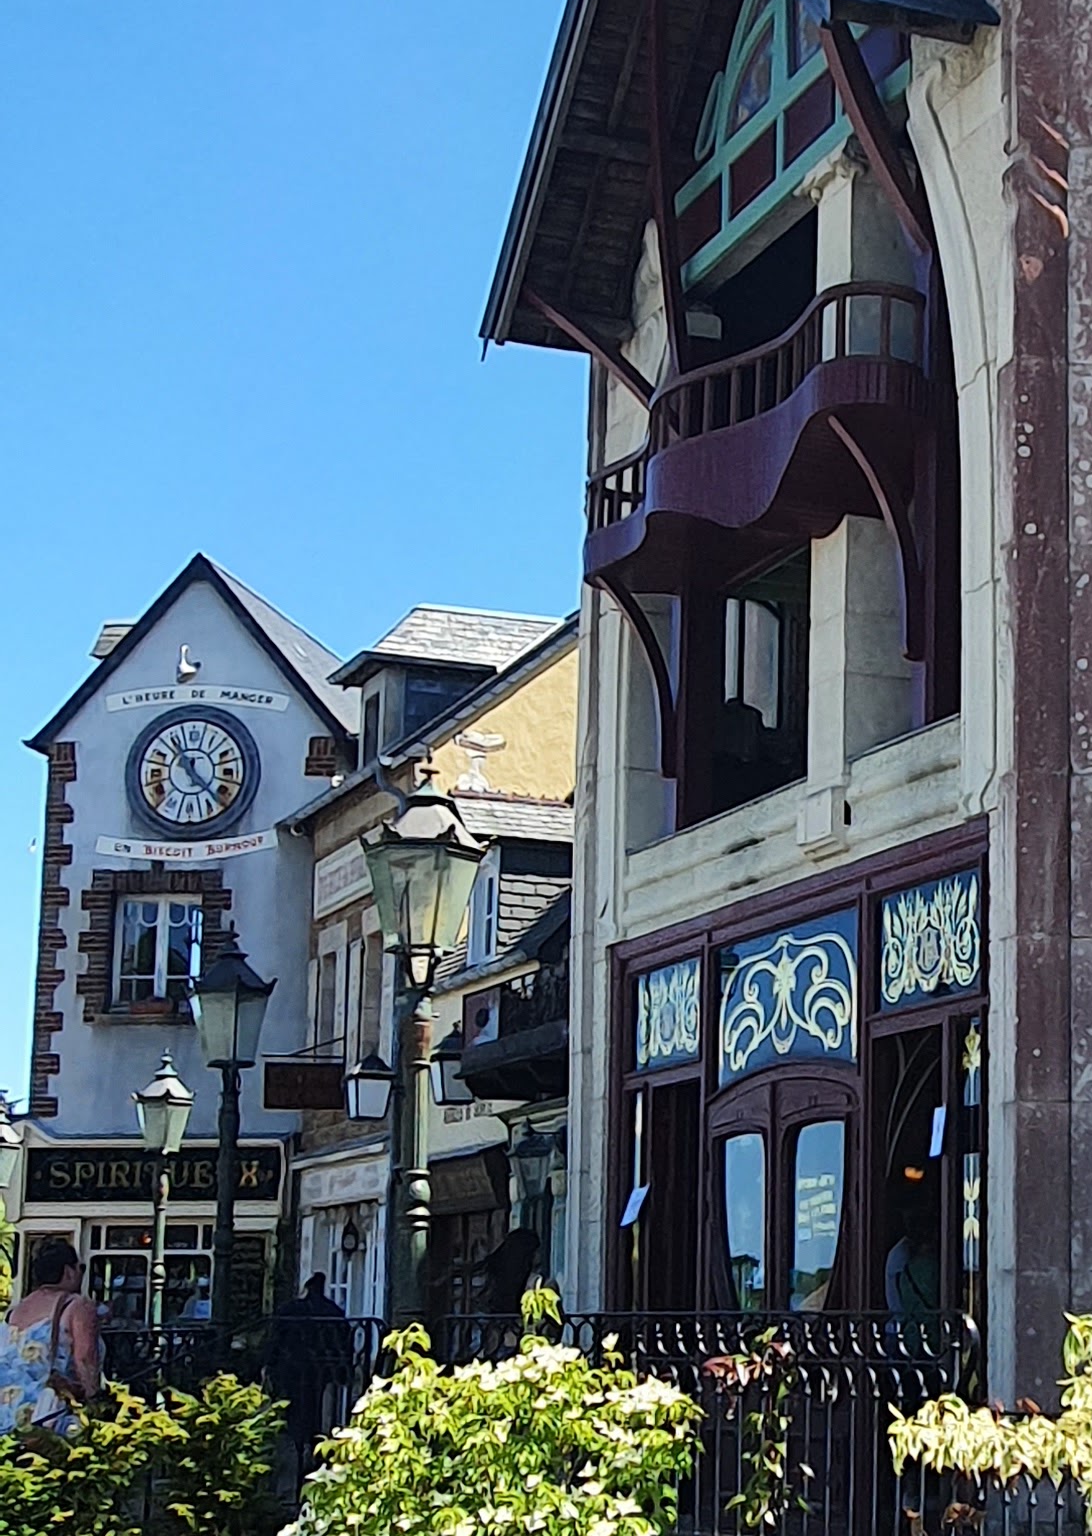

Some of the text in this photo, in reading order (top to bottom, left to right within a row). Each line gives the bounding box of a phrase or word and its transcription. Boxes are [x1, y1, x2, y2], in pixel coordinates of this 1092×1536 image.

[191, 689, 206, 698] DE
[219, 690, 274, 705] MANGER
[50, 1159, 259, 1189] SPIRITUEX
